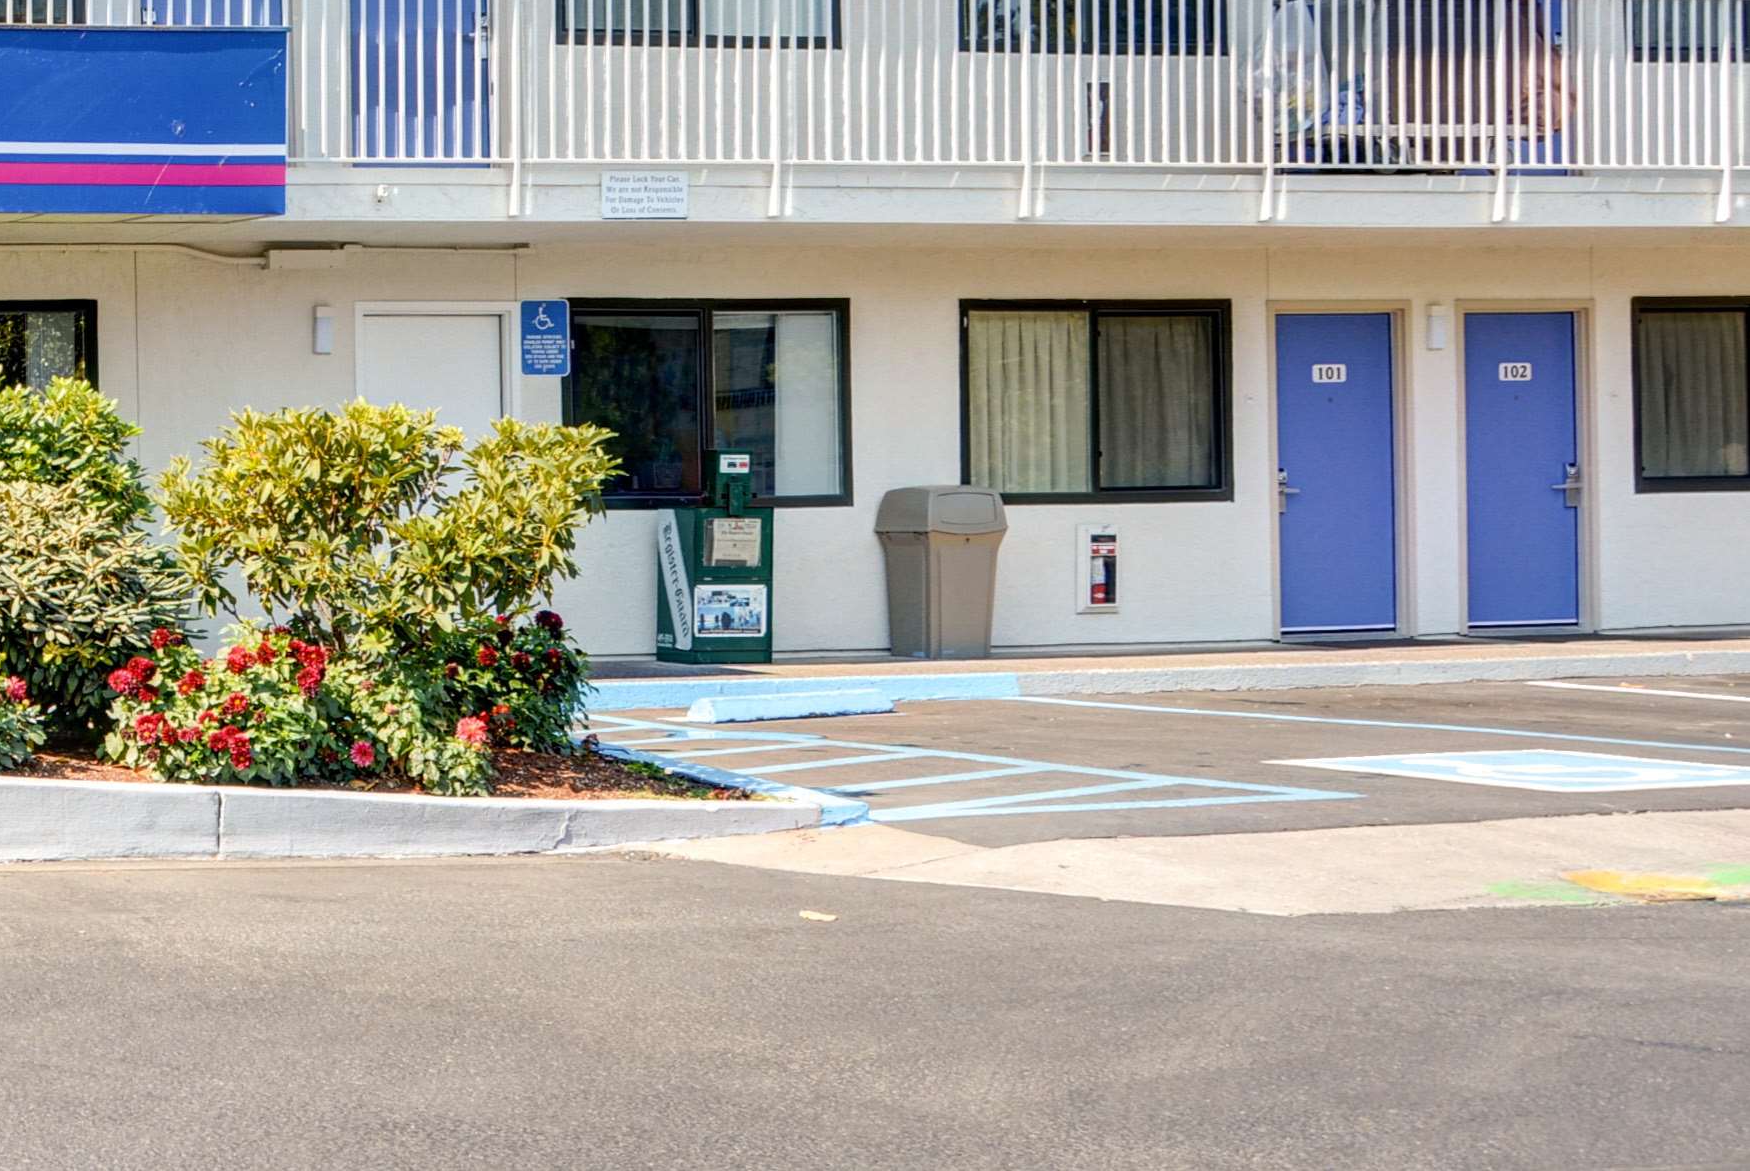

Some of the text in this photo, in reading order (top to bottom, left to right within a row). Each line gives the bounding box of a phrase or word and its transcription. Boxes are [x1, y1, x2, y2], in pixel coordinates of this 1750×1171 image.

[609, 175, 631, 183] Please
[632, 174, 648, 183] Lock
[650, 175, 666, 183] Your
[618, 195, 644, 205] Damage
[1317, 366, 1342, 380] 101
[1503, 365, 1528, 379] 102
